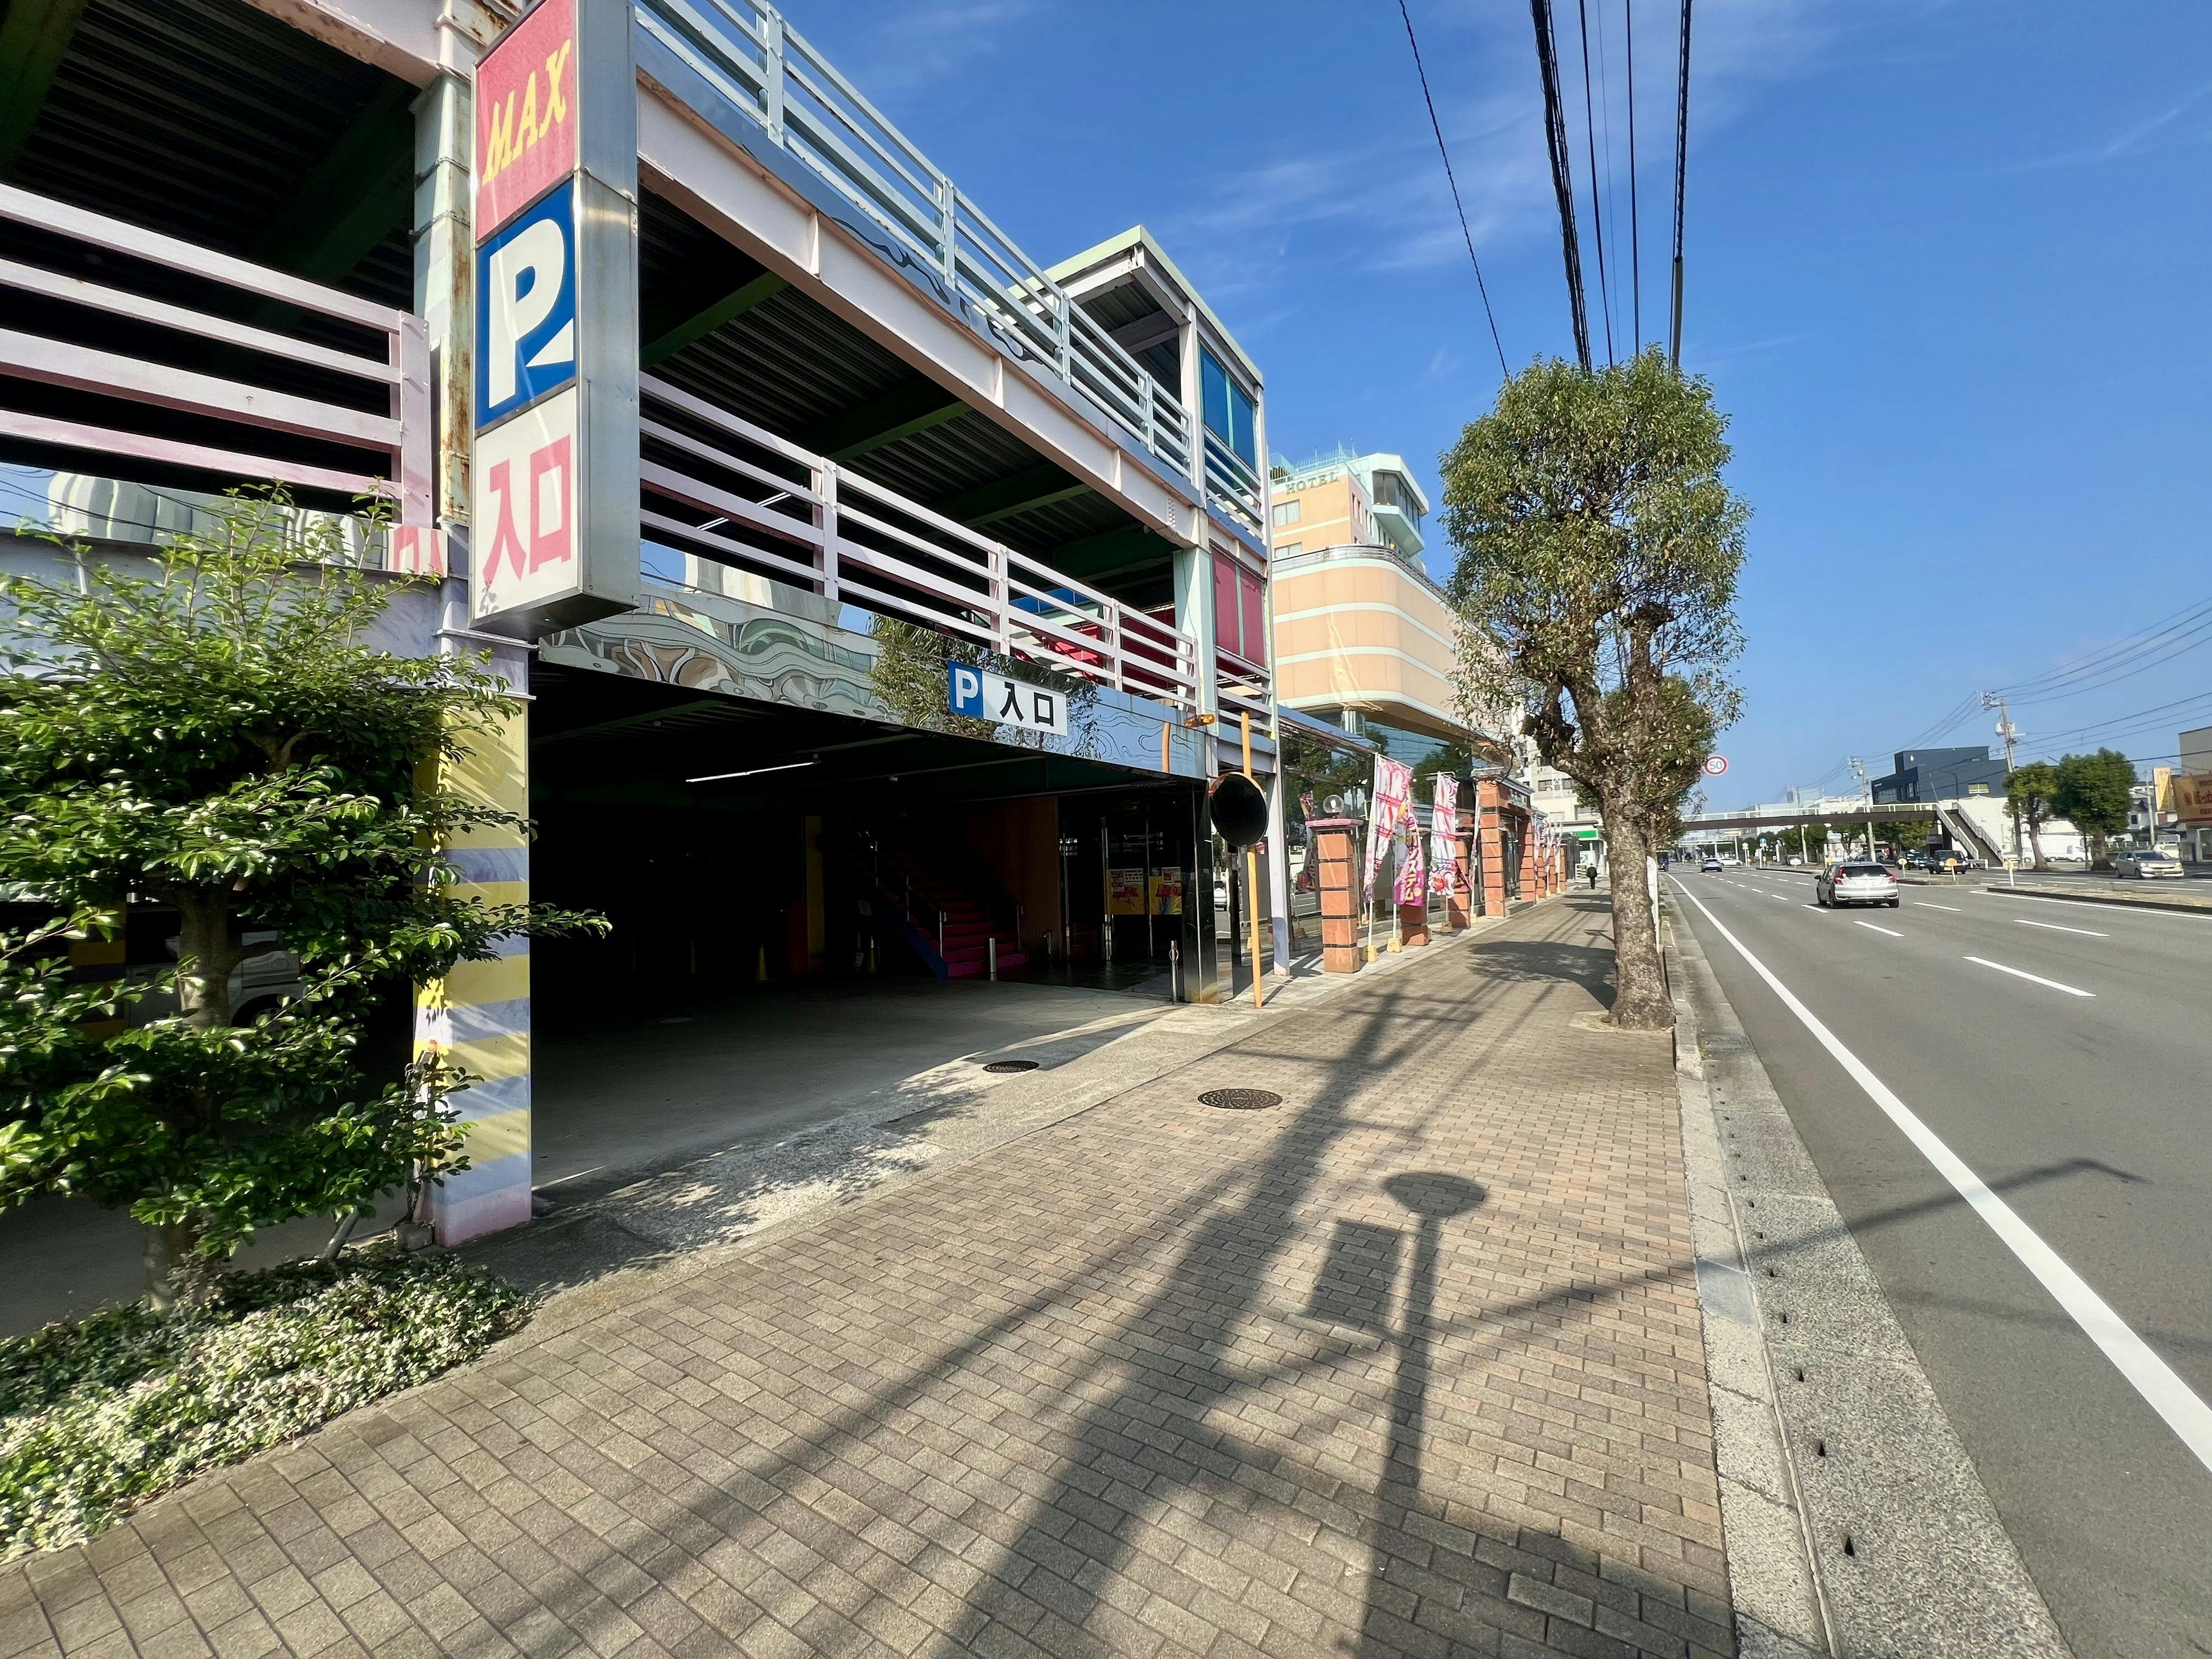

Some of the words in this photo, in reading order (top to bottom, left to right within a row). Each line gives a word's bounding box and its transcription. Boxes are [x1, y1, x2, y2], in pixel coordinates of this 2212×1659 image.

[482, 38, 571, 187] MAX
[489, 218, 565, 409] P
[483, 434, 571, 585] 入口
[1285, 471, 1339, 495] HOTEL
[955, 668, 978, 709] P
[999, 681, 1054, 727] 入口
[1709, 761, 1723, 770] 50
